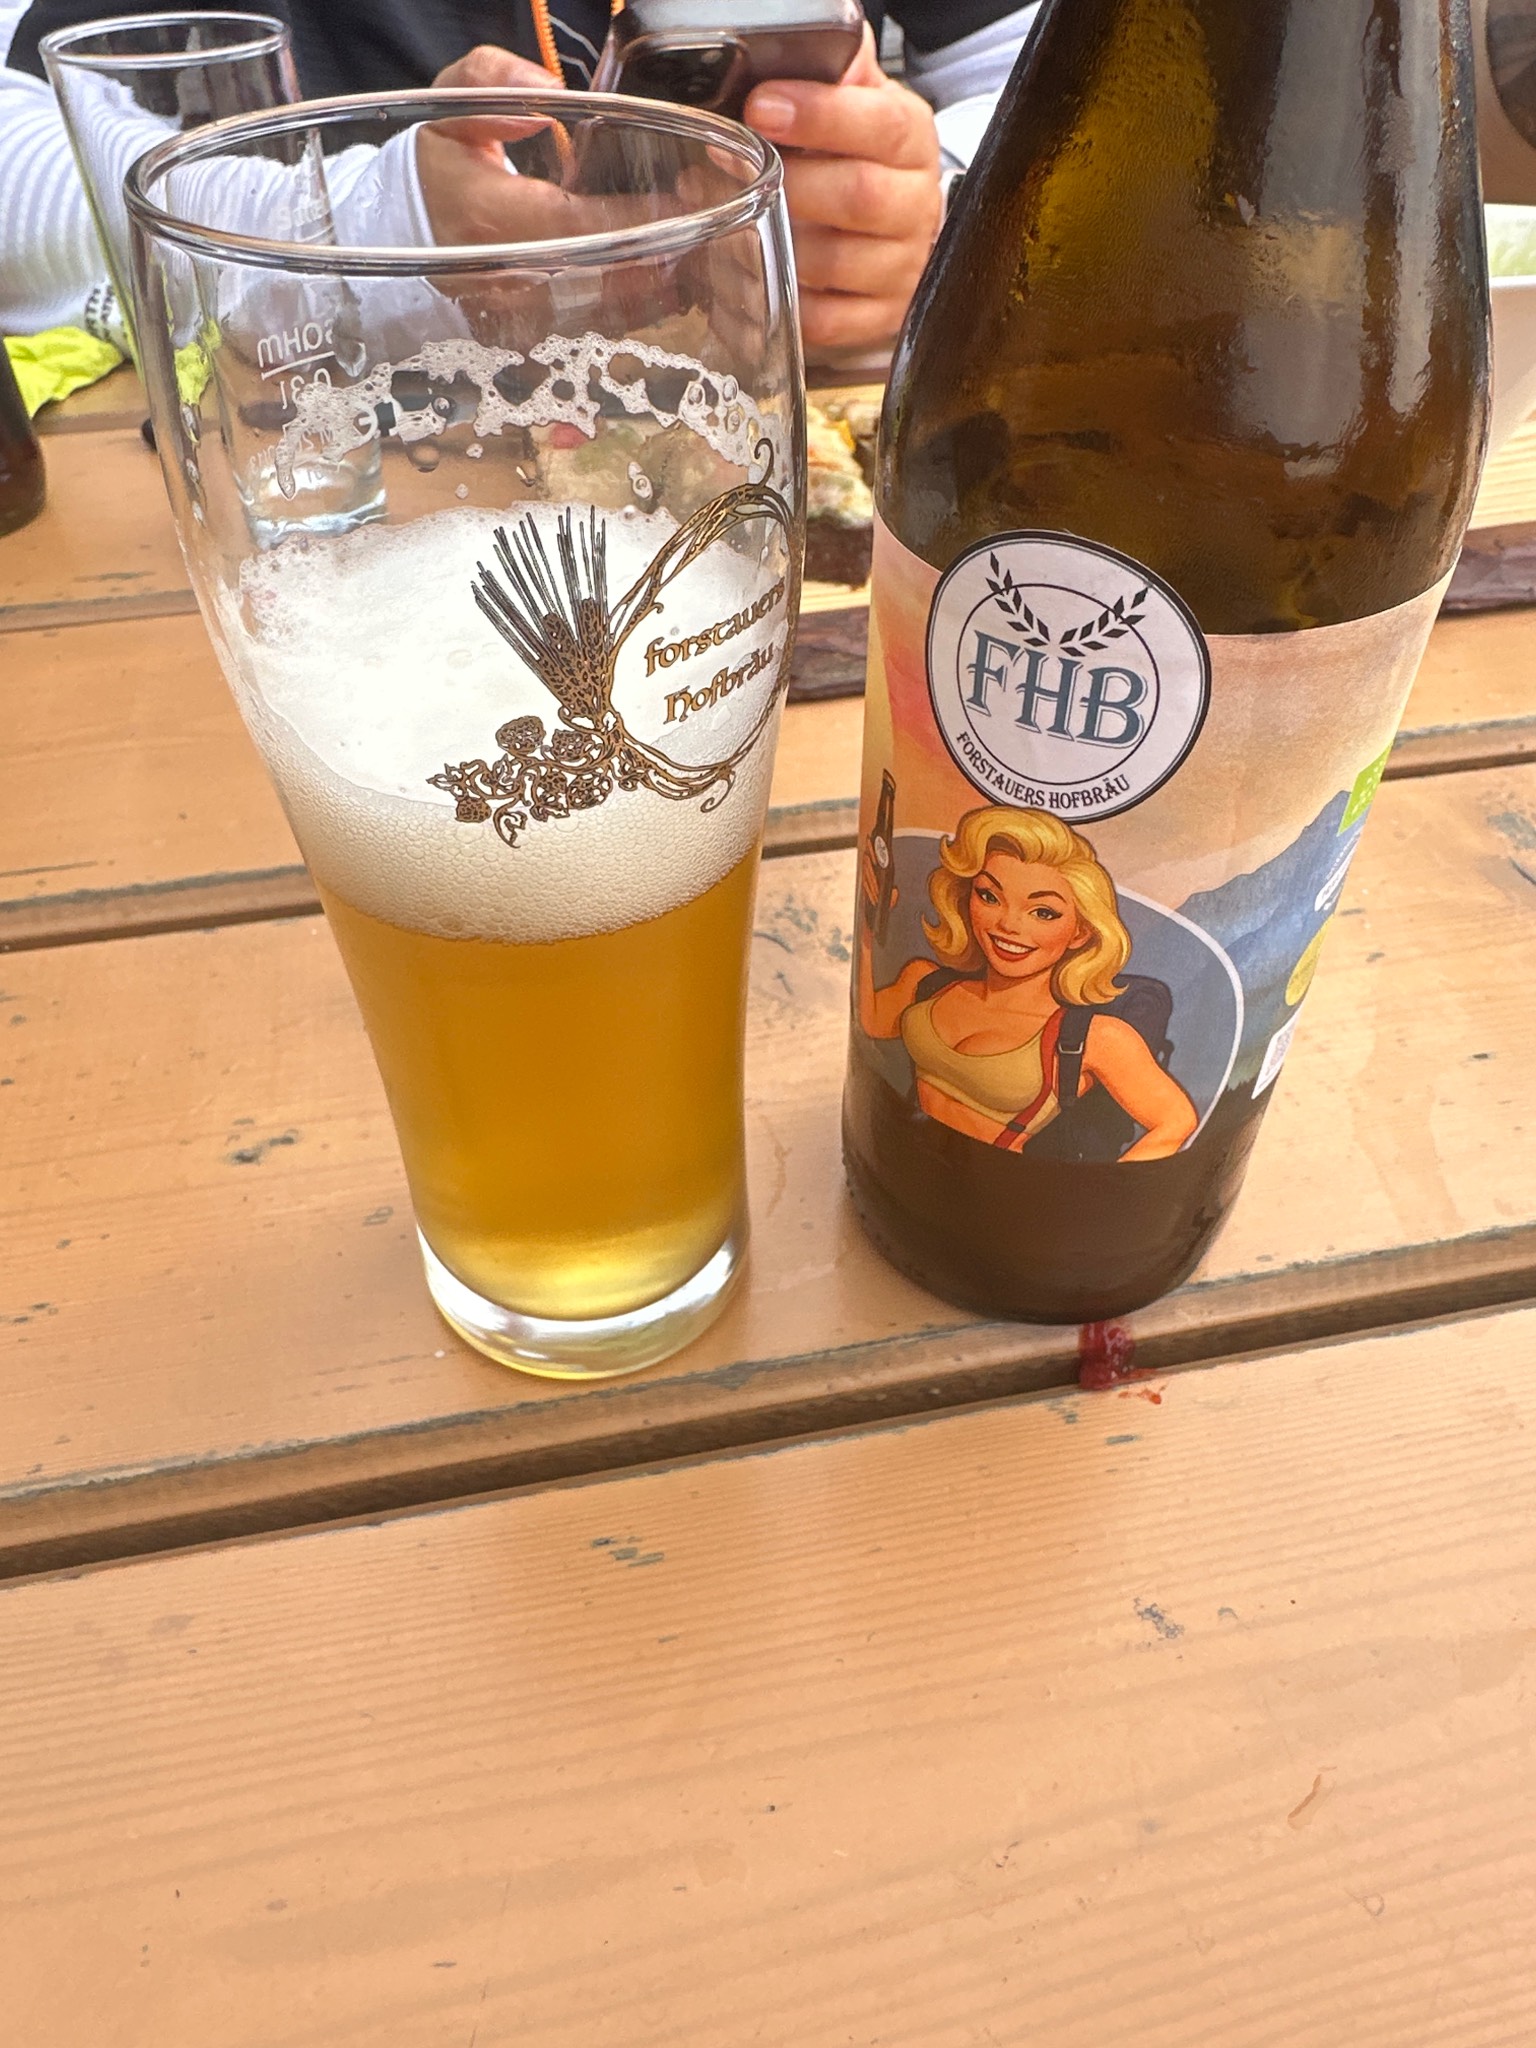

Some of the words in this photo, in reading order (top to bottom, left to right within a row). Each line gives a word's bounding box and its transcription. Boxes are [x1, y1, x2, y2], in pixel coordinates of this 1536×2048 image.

[966, 629, 1148, 749] FHB
[956, 731, 1045, 806] FORSTAUERS
[1049, 773, 1130, 809] HOFBRÄU
